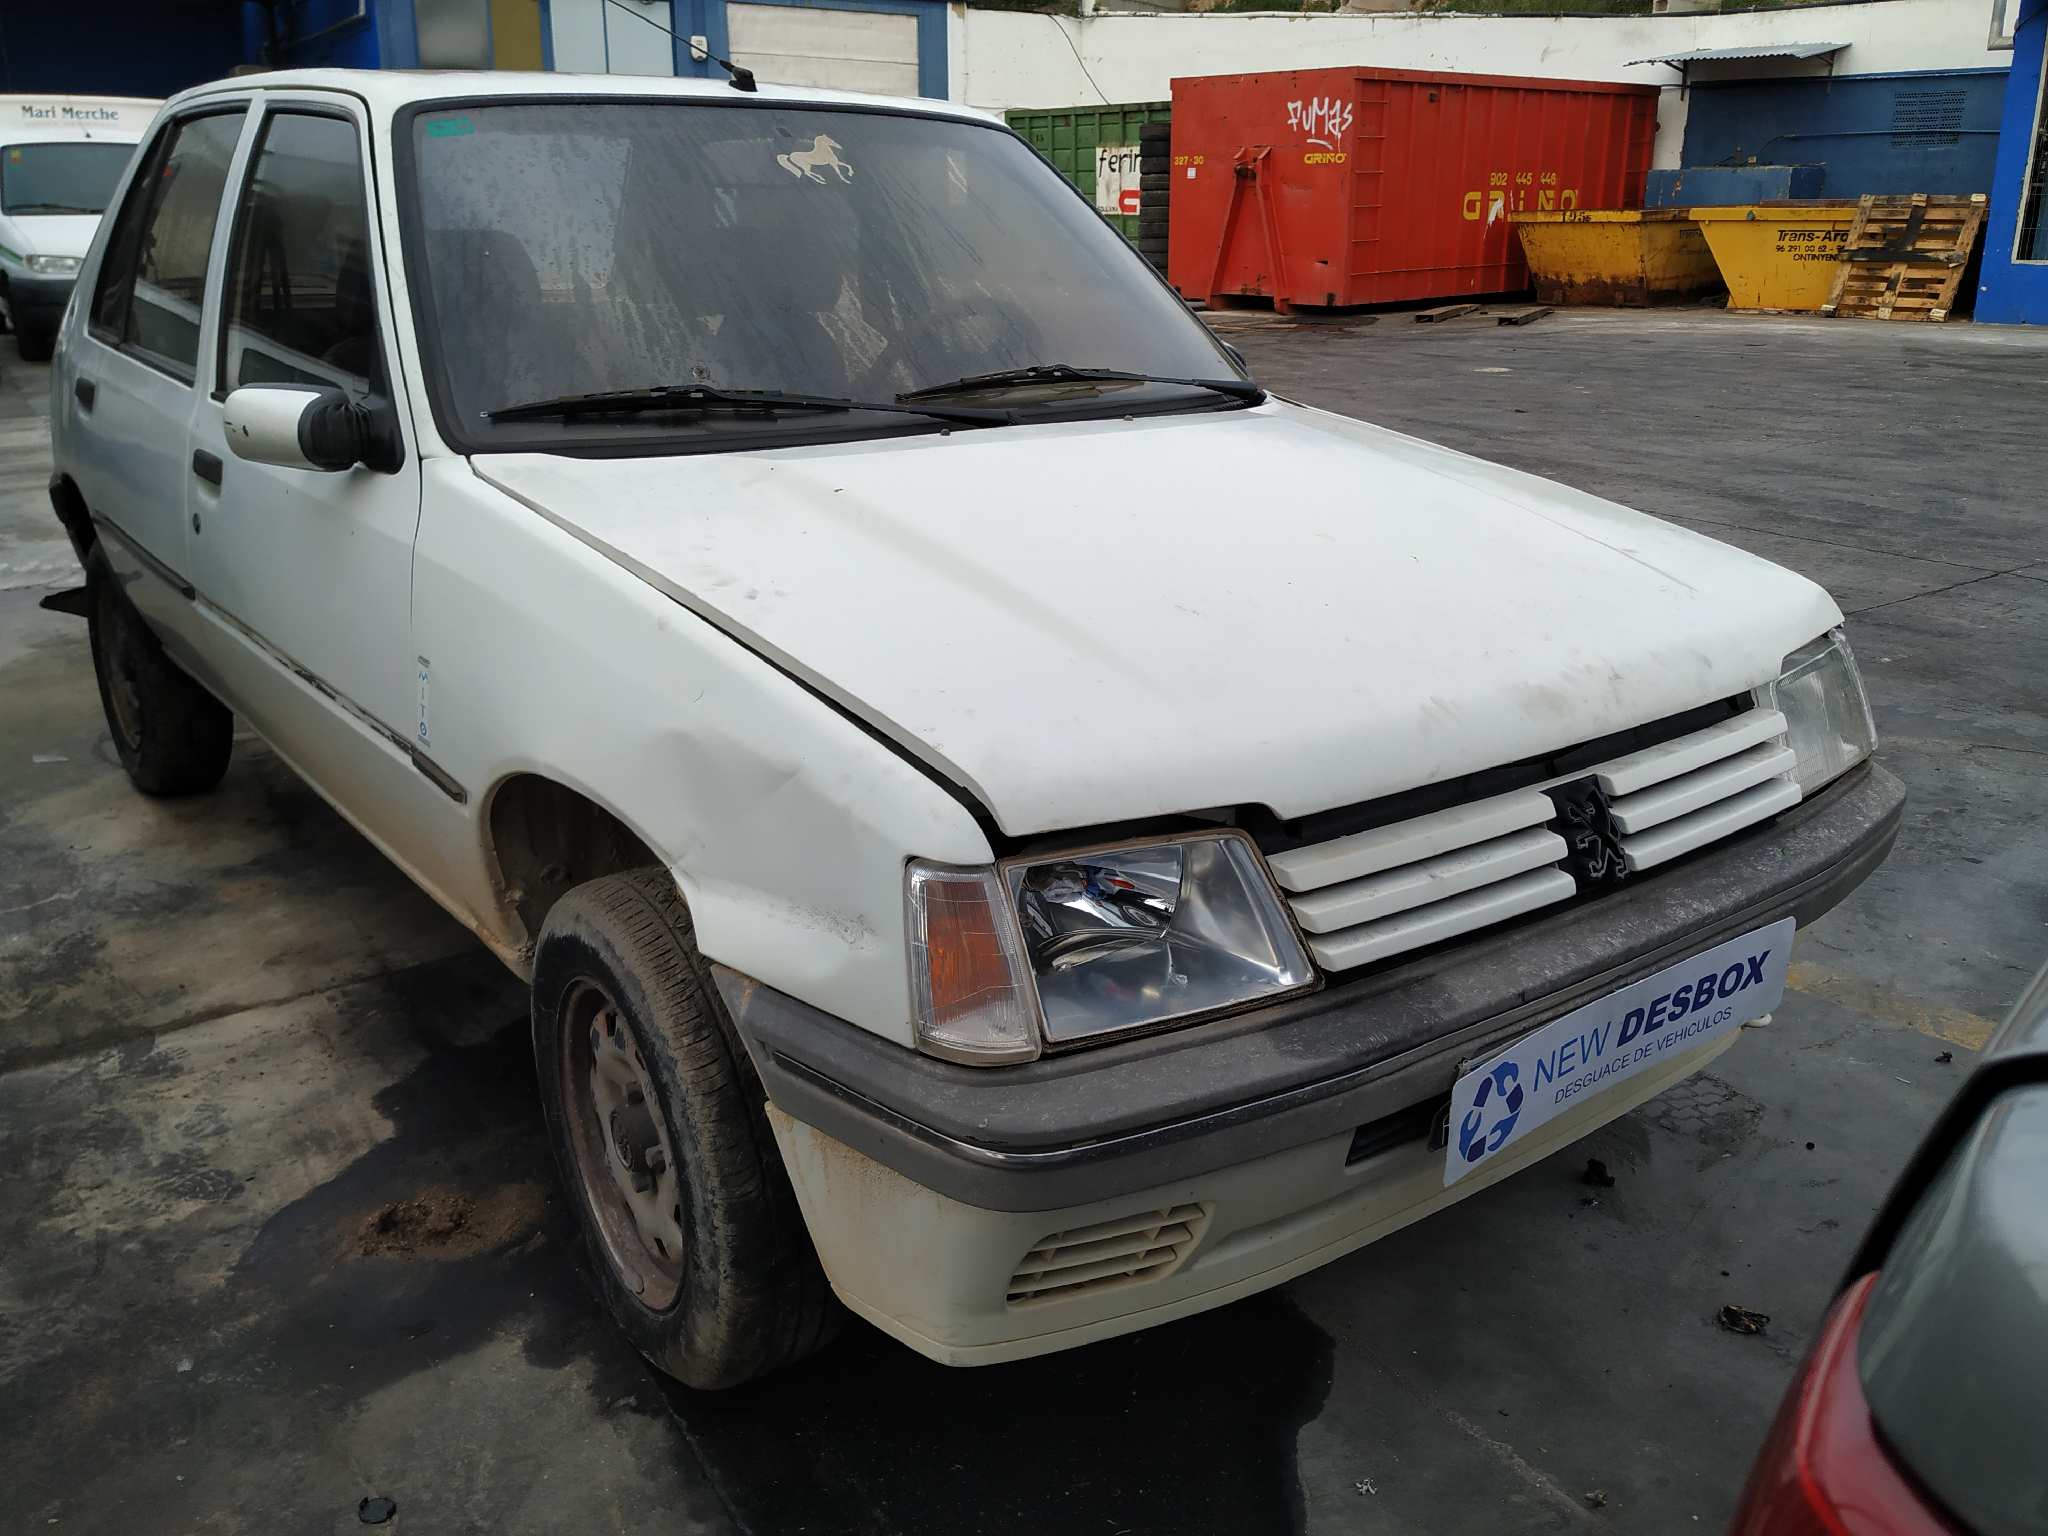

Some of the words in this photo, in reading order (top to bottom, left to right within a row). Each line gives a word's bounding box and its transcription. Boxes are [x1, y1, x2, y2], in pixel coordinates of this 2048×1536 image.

[21, 105, 56, 118] Mari
[62, 106, 120, 121] Merche
[1490, 172, 1508, 186] 902
[1515, 172, 1533, 186] 445
[1534, 1021, 1612, 1093] NEW
[1616, 949, 1772, 1048] DESBOX
[1554, 1054, 1631, 1104] DESGUACE
[1633, 1042, 1654, 1063] DE
[1657, 1007, 1732, 1051] VEHICULOS
